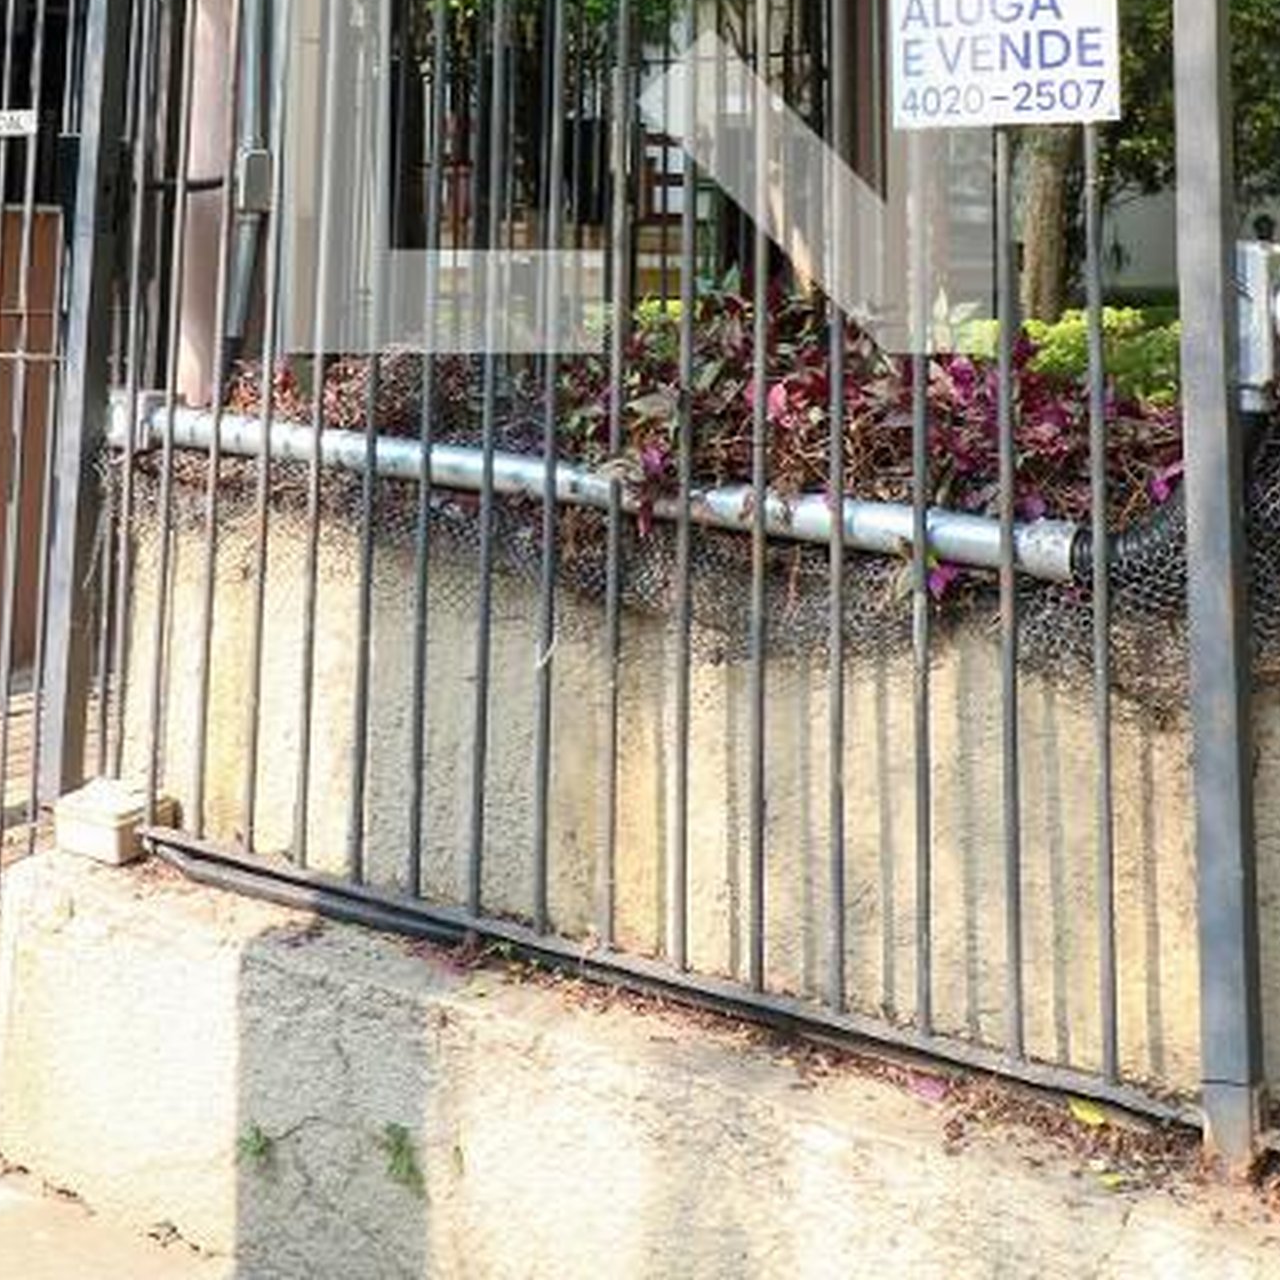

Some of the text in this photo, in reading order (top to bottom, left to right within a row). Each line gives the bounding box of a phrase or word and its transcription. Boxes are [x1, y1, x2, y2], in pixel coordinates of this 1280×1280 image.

[903, 28, 1106, 77] E VENDE
[902, 79, 1107, 118] 4020-2507
